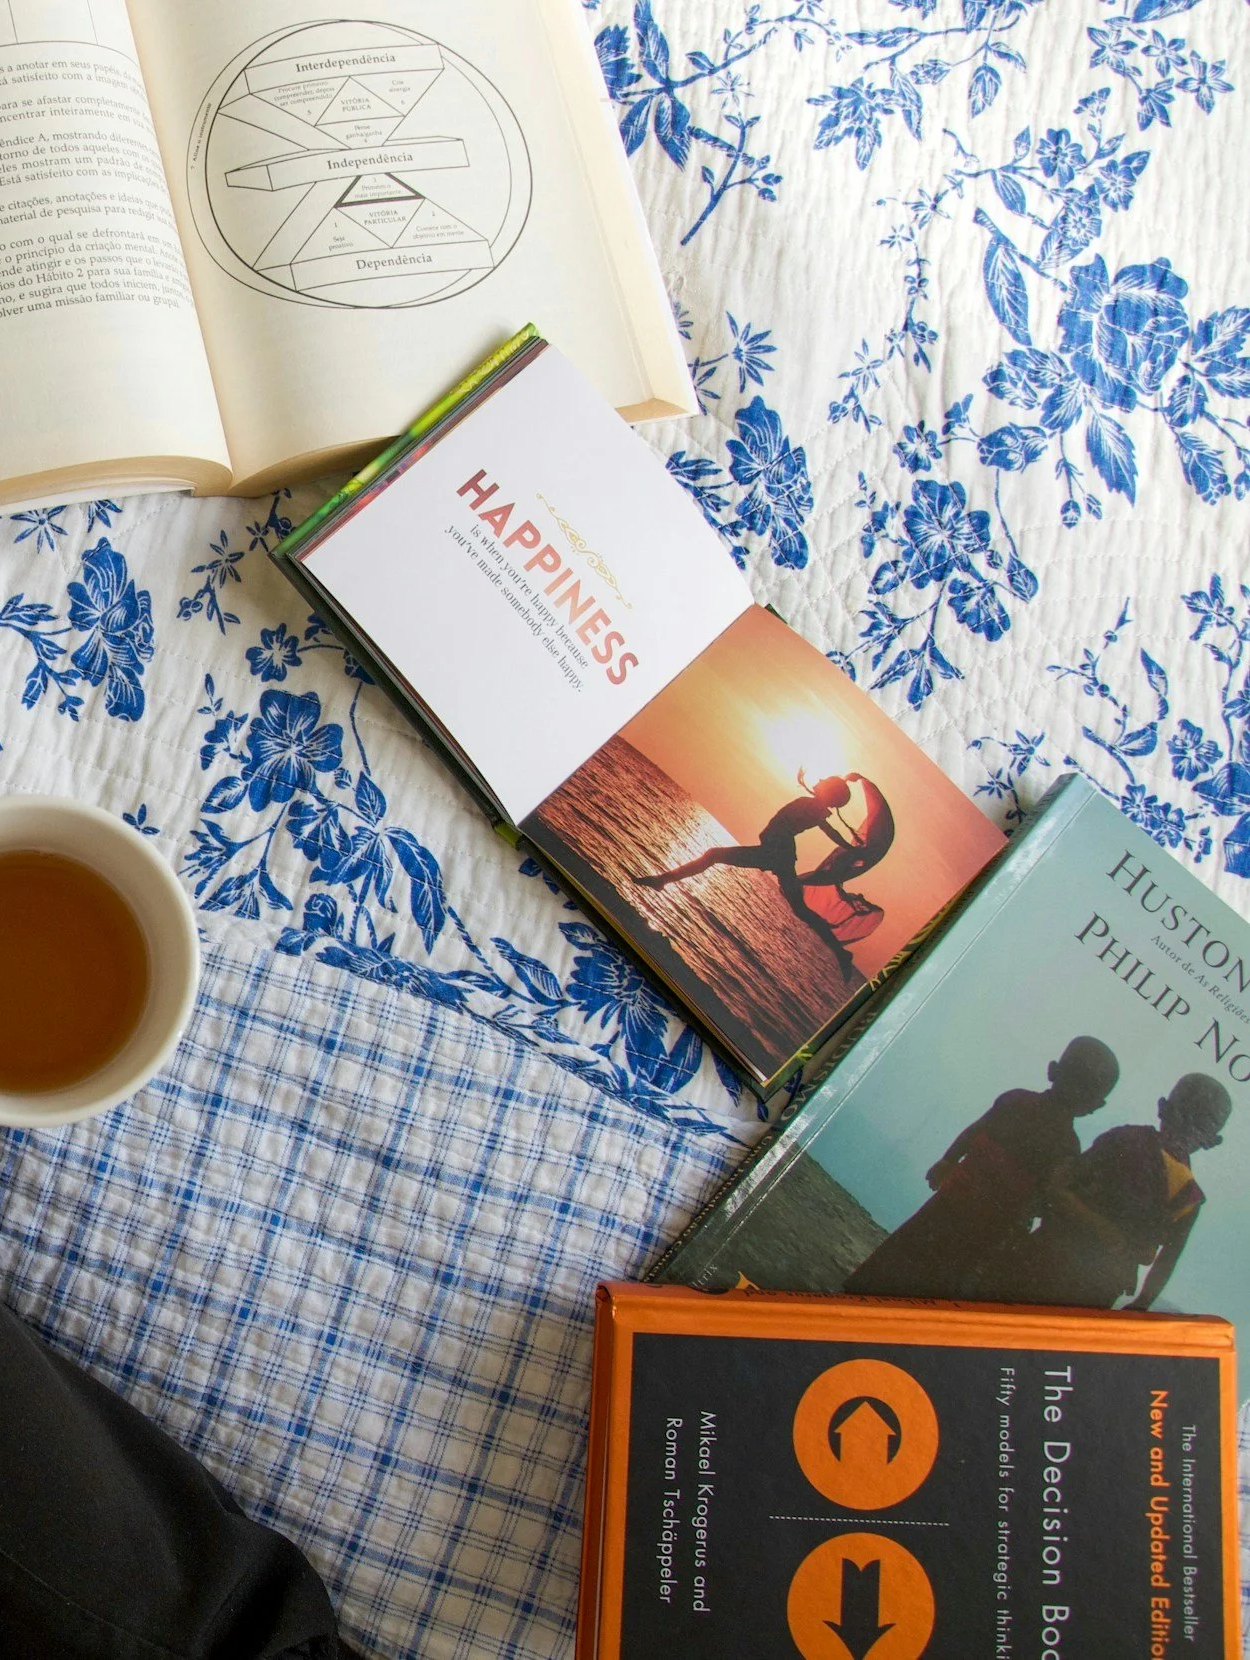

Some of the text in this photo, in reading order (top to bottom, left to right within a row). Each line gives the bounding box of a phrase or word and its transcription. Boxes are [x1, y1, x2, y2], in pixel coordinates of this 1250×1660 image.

[12, 72, 58, 84] satisfeito
[16, 61, 49, 71] anotar
[70, 61, 91, 69] seus
[296, 54, 396, 72] Interdependência
[327, 153, 413, 170] Independência
[18, 276, 33, 287] do
[36, 271, 74, 284] Hábito
[76, 268, 84, 278] 2
[86, 268, 110, 280] para
[356, 252, 432, 270] Dependência
[27, 301, 52, 312] uma
[55, 294, 93, 307] missão
[95, 291, 135, 302] familiar
[456, 468, 639, 685] HAPPINESS
[470, 524, 481, 538] is
[480, 534, 504, 563] when
[530, 592, 558, 627] happy
[556, 624, 589, 669] because
[477, 558, 502, 587] made
[500, 586, 544, 637] somebody
[542, 634, 560, 658] else
[558, 654, 584, 692] happy.
[1106, 849, 1250, 994] HUSTON
[1074, 912, 1190, 1022] PHILIP
[1151, 935, 1182, 964] Autor
[1181, 961, 1196, 976] de
[1194, 974, 1209, 988] As
[996, 1366, 1015, 1406] Fifty
[1044, 1366, 1074, 1423] The
[998, 1415, 1015, 1478] models
[657, 1417, 683, 1603] Roman Tschäppeler
[692, 1410, 717, 1612] Mikael Krogerus and
[998, 1487, 1014, 1512] for
[1042, 1442, 1071, 1586] Decision
[1145, 1390, 1172, 1660] New and Updated Editio
[993, 1521, 1013, 1600] strategic
[1182, 1424, 1199, 1642] The International Bestseller
